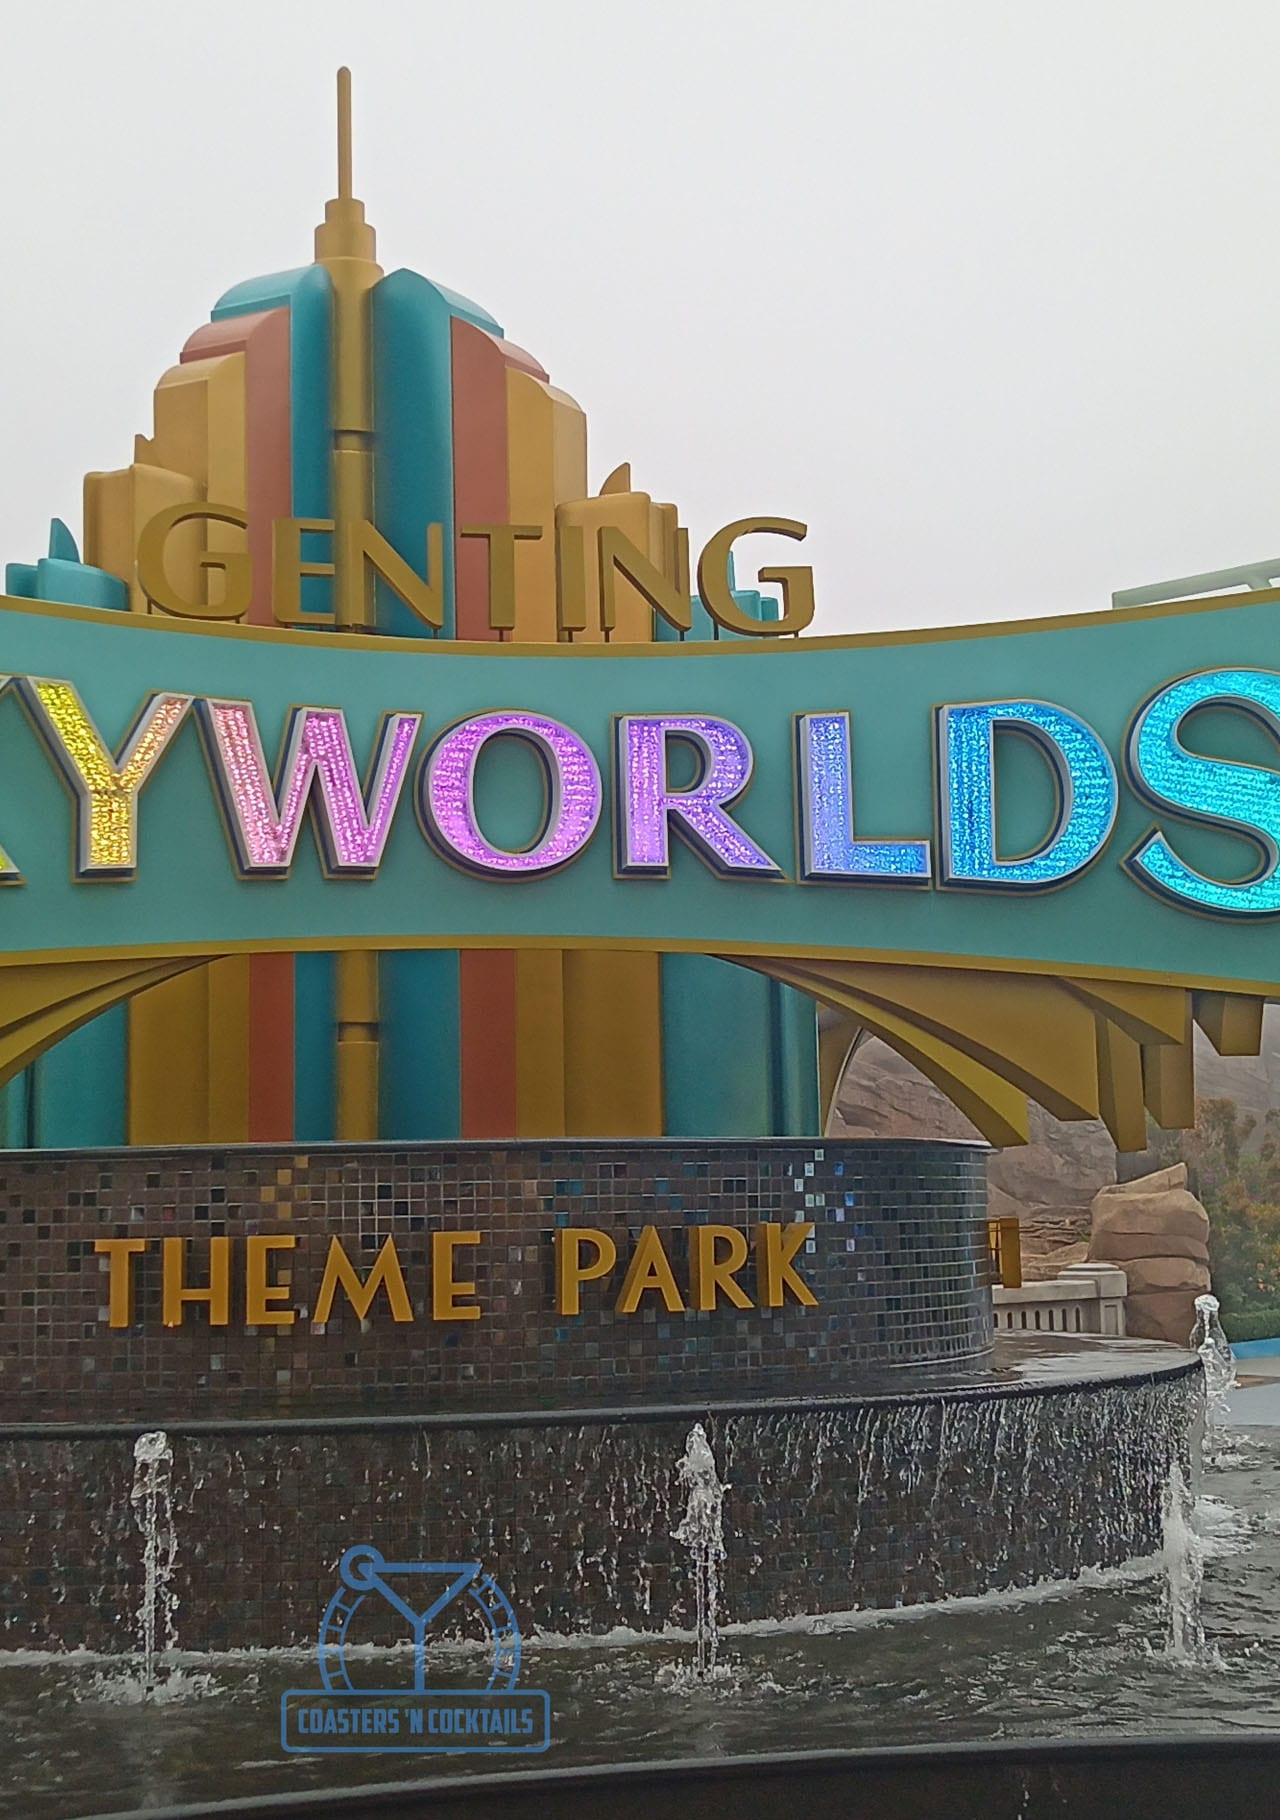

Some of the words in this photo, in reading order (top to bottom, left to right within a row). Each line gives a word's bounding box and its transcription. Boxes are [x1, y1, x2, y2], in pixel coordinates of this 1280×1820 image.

[136, 501, 816, 637] GENTING
[94, 1231, 481, 1328] THEME
[555, 1221, 819, 1315] PARK
